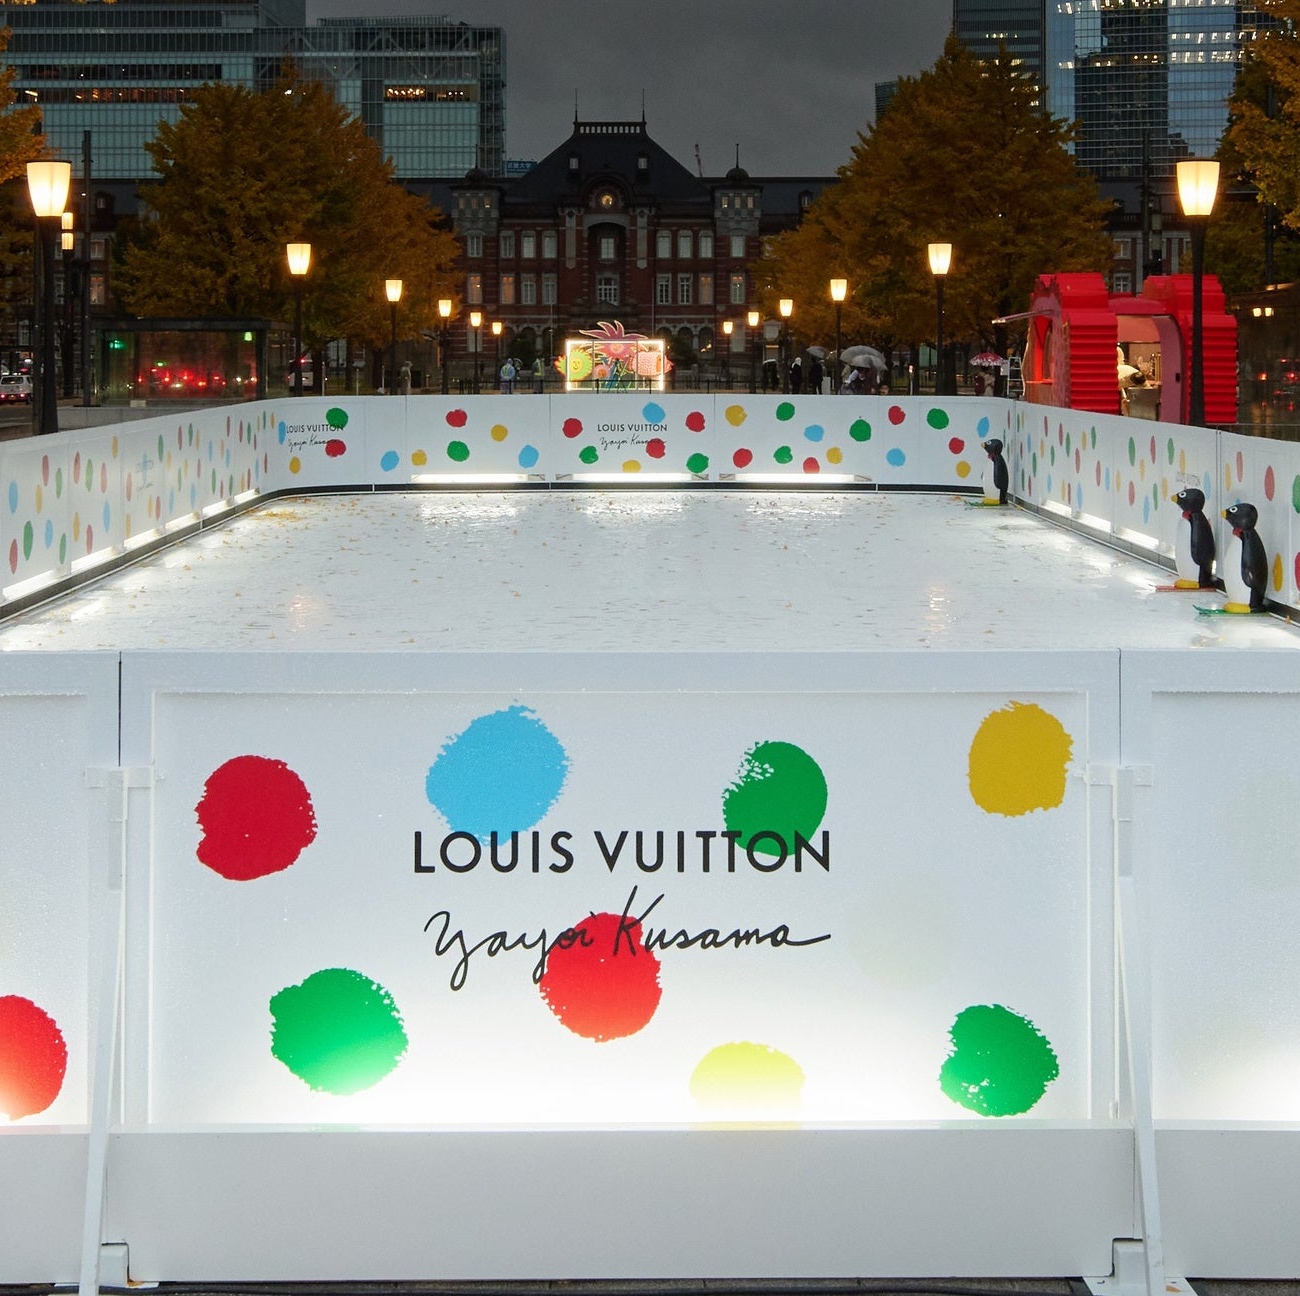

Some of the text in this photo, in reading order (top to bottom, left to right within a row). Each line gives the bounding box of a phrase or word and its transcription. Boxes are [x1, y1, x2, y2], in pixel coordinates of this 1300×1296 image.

[287, 423, 344, 434] LOUIS VUITTON
[597, 423, 668, 432] LOUIS VUITTON
[413, 830, 832, 874] LOUIS VUITTON
[423, 884, 832, 992] Yayoi Kusama
